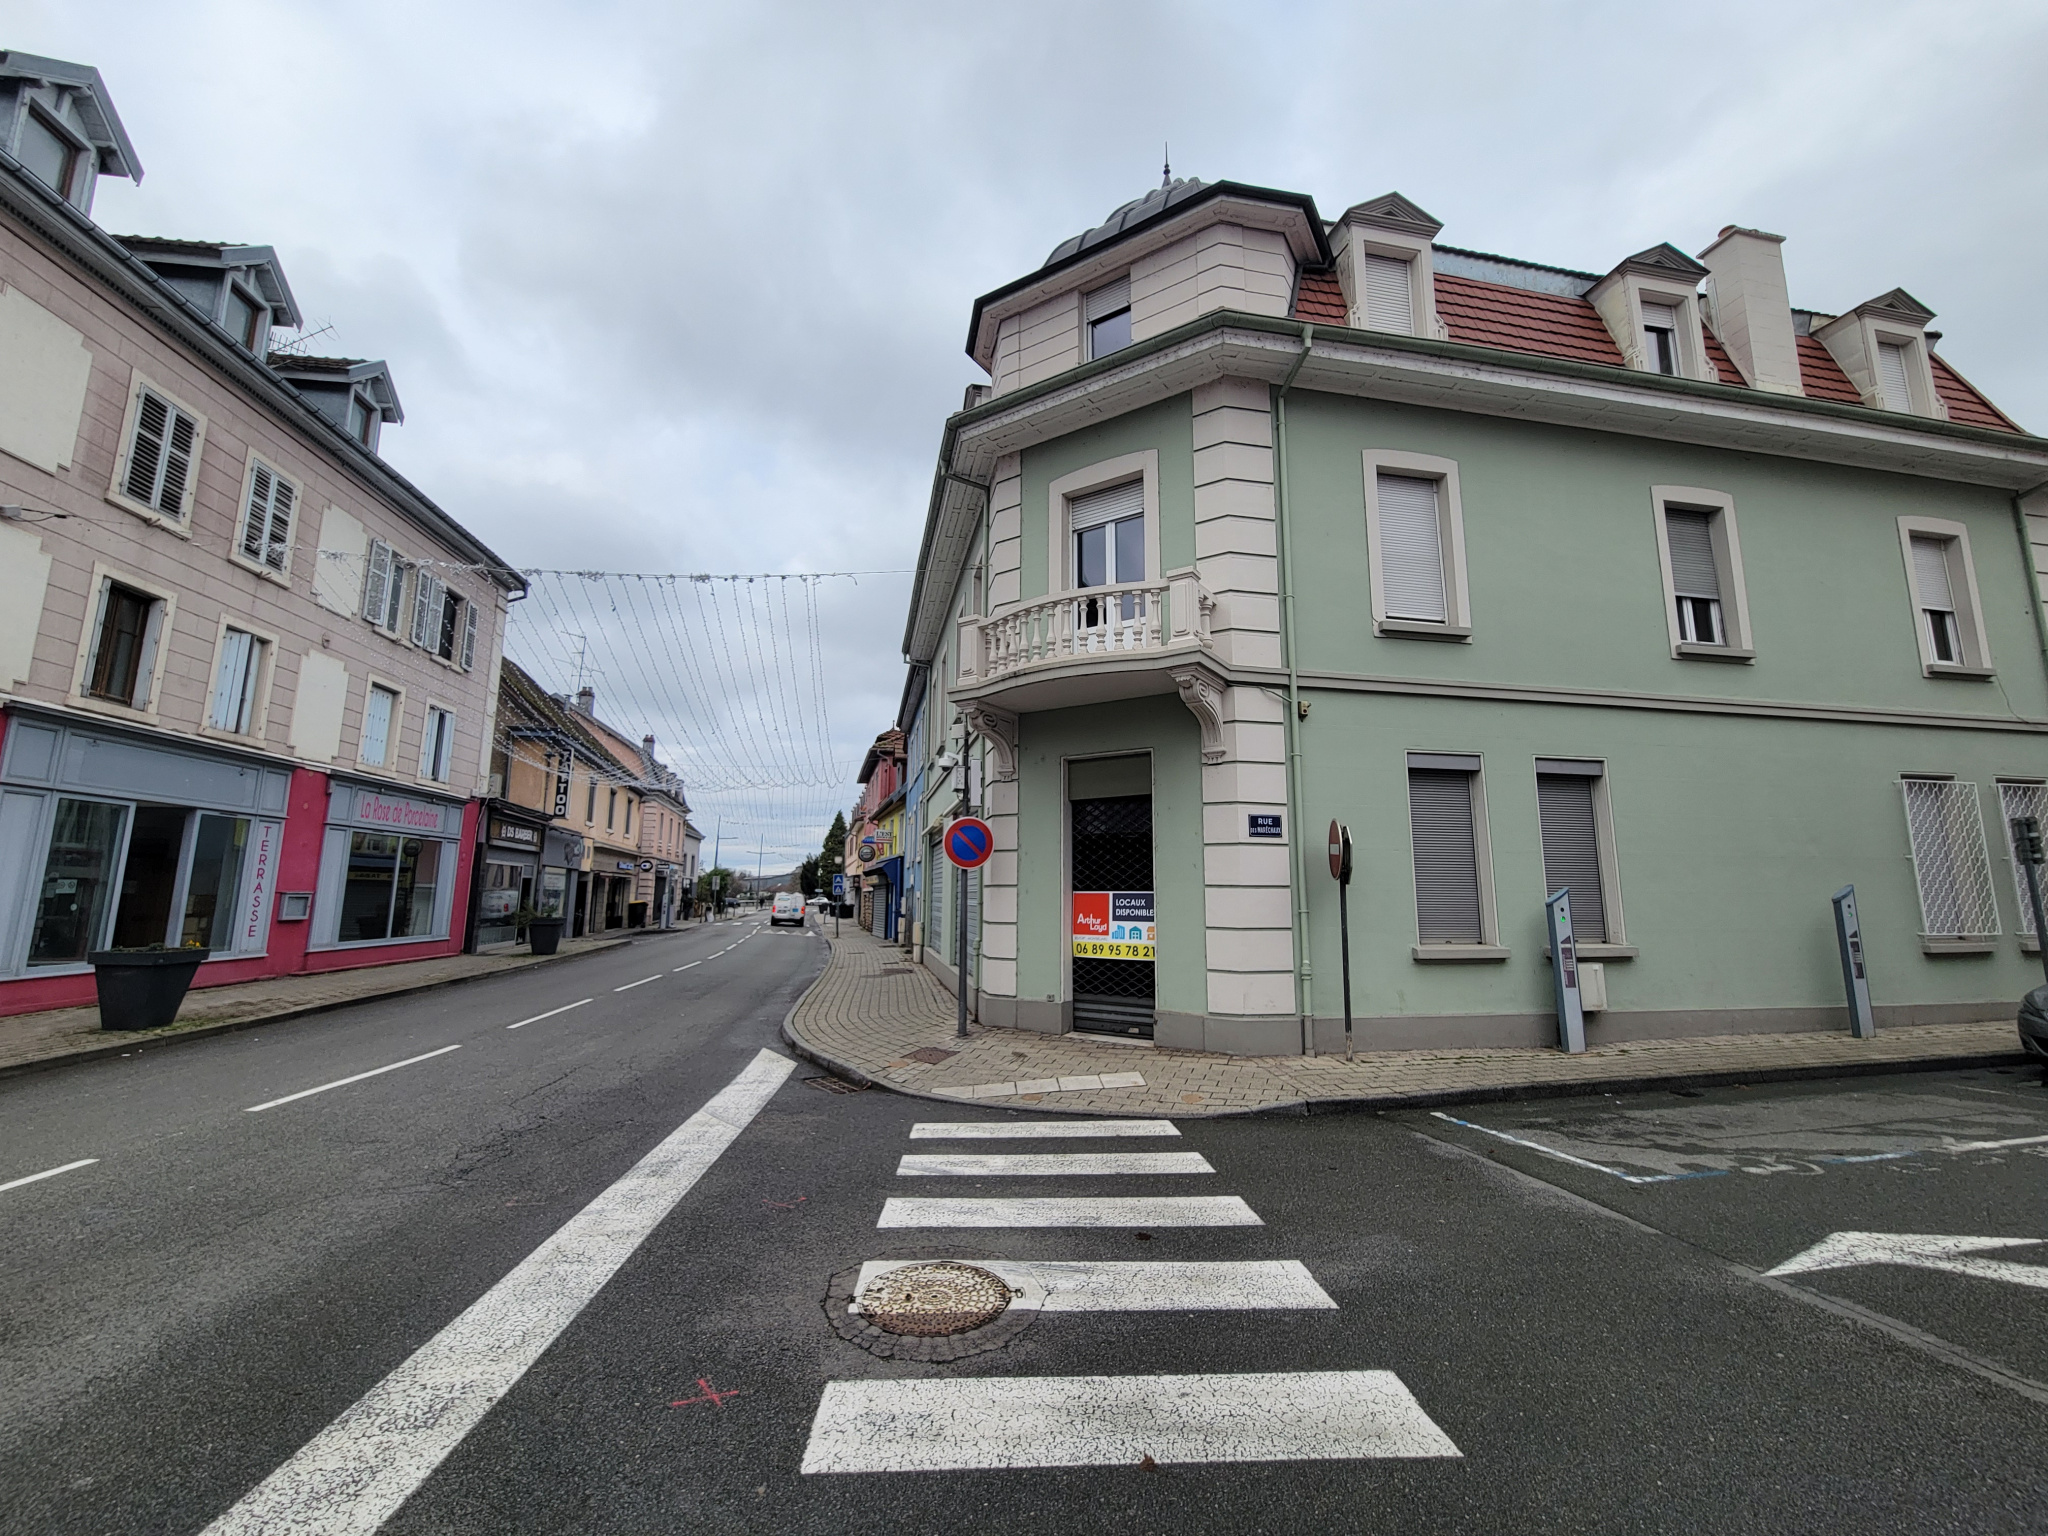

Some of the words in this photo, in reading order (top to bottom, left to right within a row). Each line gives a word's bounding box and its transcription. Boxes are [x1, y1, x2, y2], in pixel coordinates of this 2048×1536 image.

[555, 751, 570, 815] TATTOO
[361, 793, 372, 819] La
[373, 796, 391, 822] Rose
[392, 801, 403, 823] de
[404, 801, 439, 829] Porcelaine
[1257, 817, 1273, 825] RUE
[514, 827, 533, 841] BARBER
[248, 826, 272, 937] TERRASSE
[1115, 899, 1146, 907] LOCAUX
[1077, 913, 1101, 924] Arthur
[1115, 908, 1154, 917] DISPONIBLE
[1090, 922, 1107, 932] Loyd
[1076, 943, 1088, 954] 06
[1091, 944, 1104, 955] 89
[1108, 944, 1121, 956] 95
[1125, 945, 1139, 957] 78
[1142, 946, 1155, 957] 21
